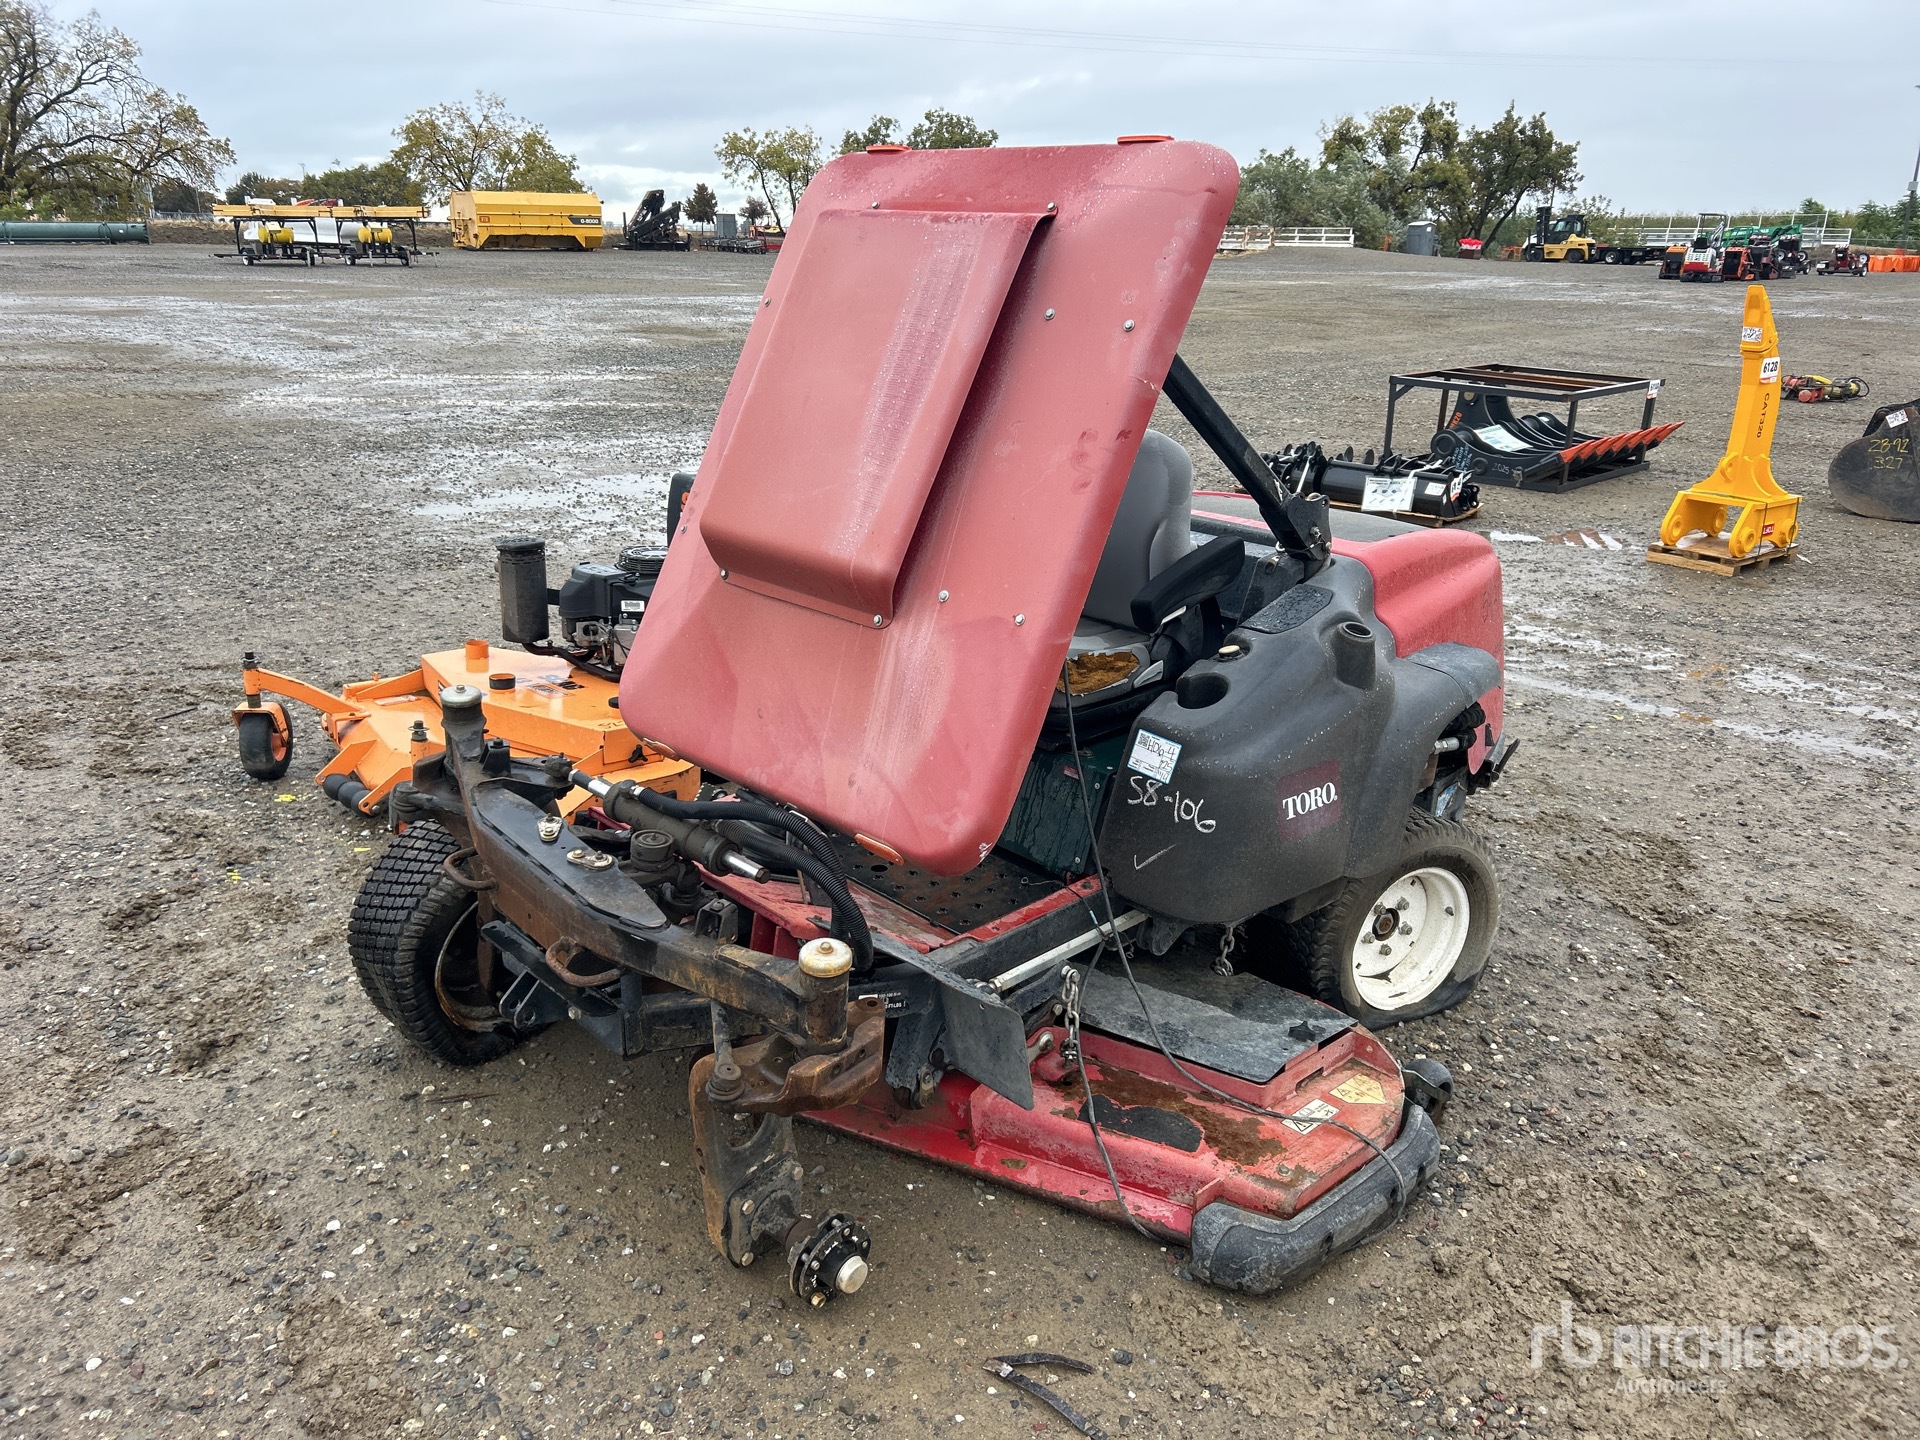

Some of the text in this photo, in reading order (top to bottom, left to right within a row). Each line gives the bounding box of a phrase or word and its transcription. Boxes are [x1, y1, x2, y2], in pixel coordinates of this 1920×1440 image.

[1762, 361, 1779, 374] 6128
[1756, 392, 1770, 438] CAT320
[1868, 437, 1910, 453] 28-92
[1491, 462, 1510, 475] 2025
[1873, 455, 1903, 469] 327
[1282, 782, 1337, 820] TORO
